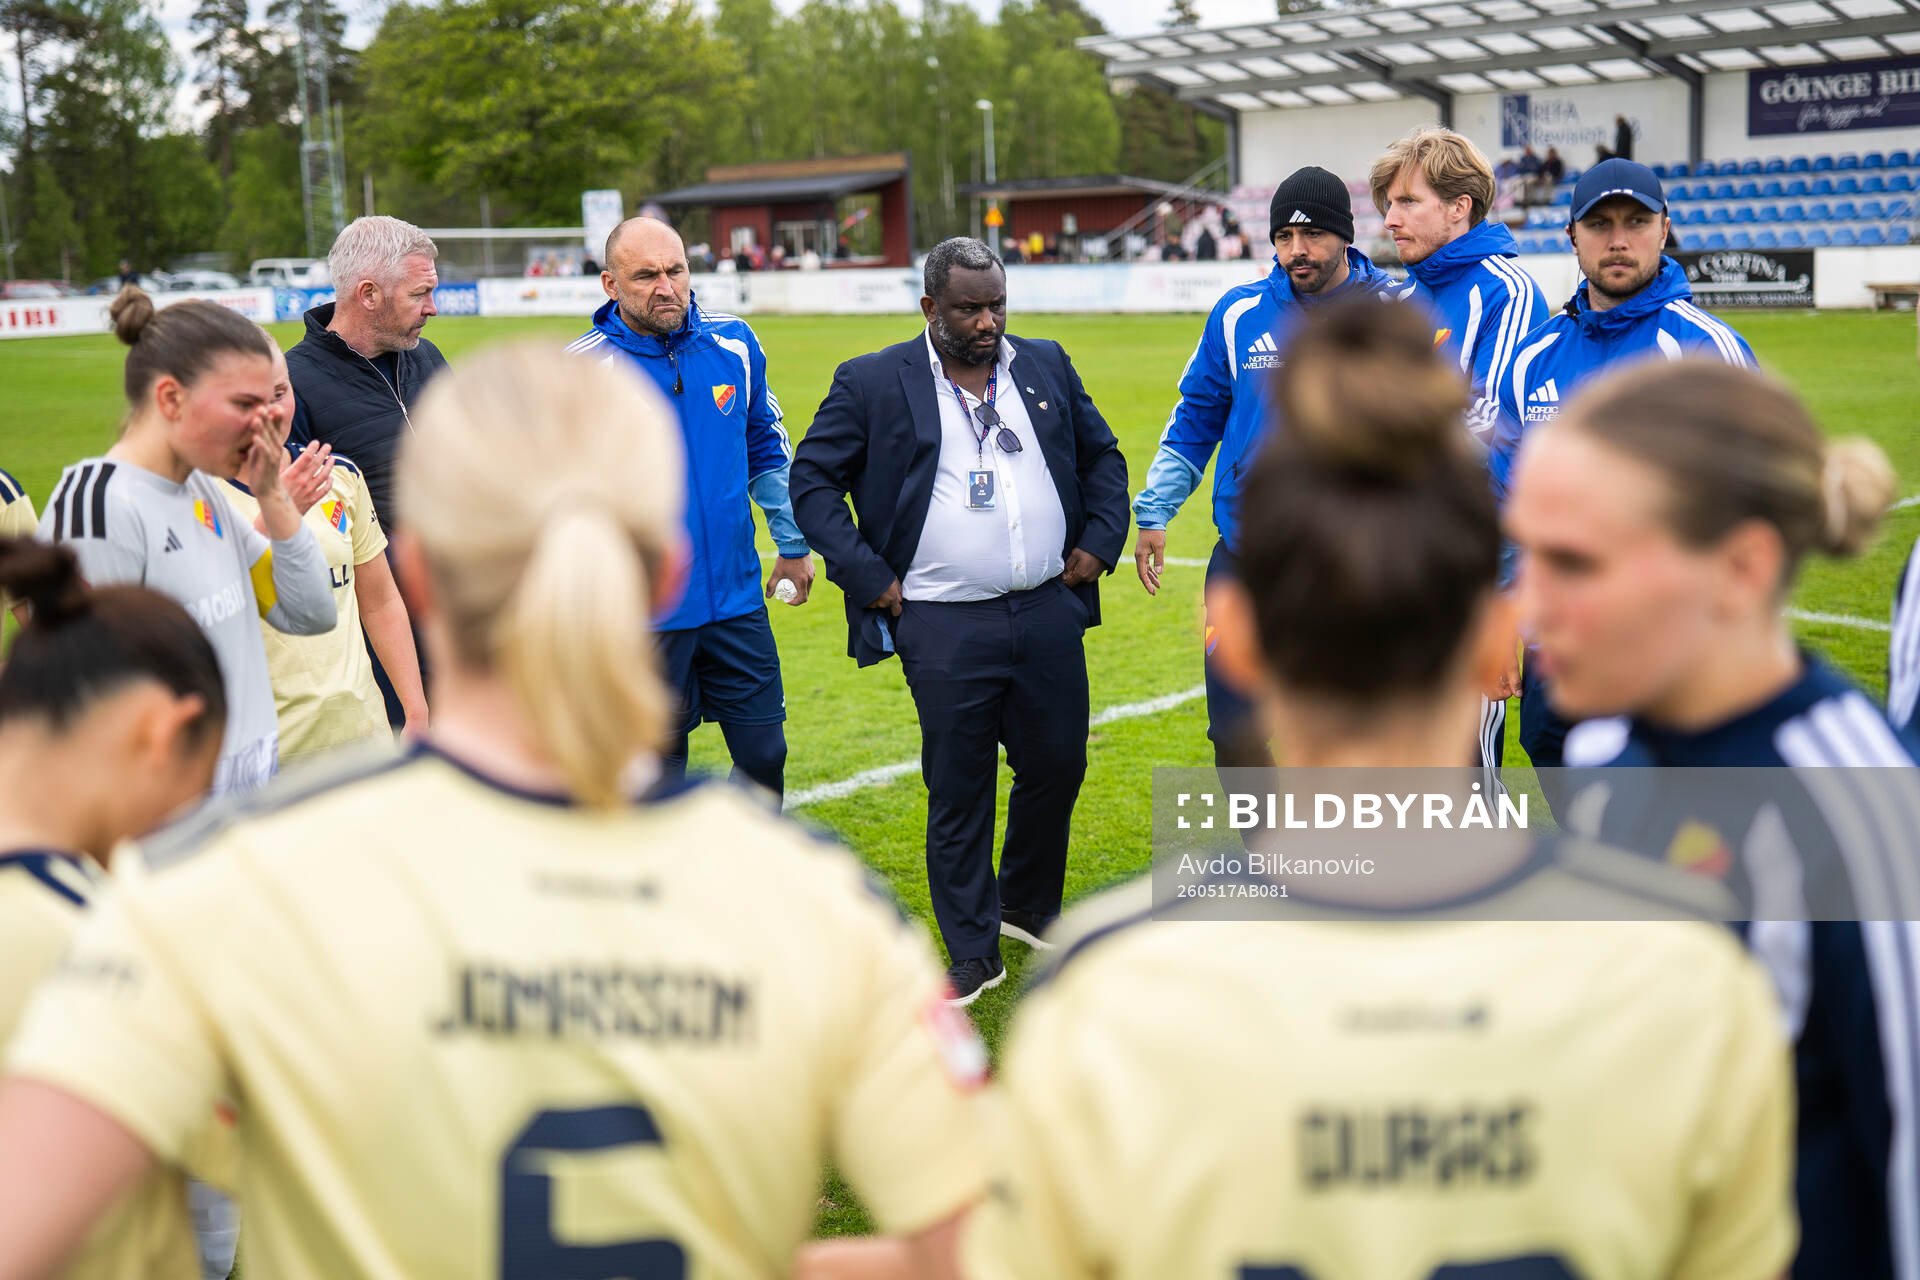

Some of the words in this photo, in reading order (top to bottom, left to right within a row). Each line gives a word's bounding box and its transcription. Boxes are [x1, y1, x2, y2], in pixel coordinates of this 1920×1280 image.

[1760, 72, 1872, 104] GÖINGE
[1534, 127, 1606, 144] Revision
[1248, 355, 1279, 363] NORDIC
[1242, 361, 1288, 370] WELLNESS
[1527, 405, 1560, 414] NORDIC
